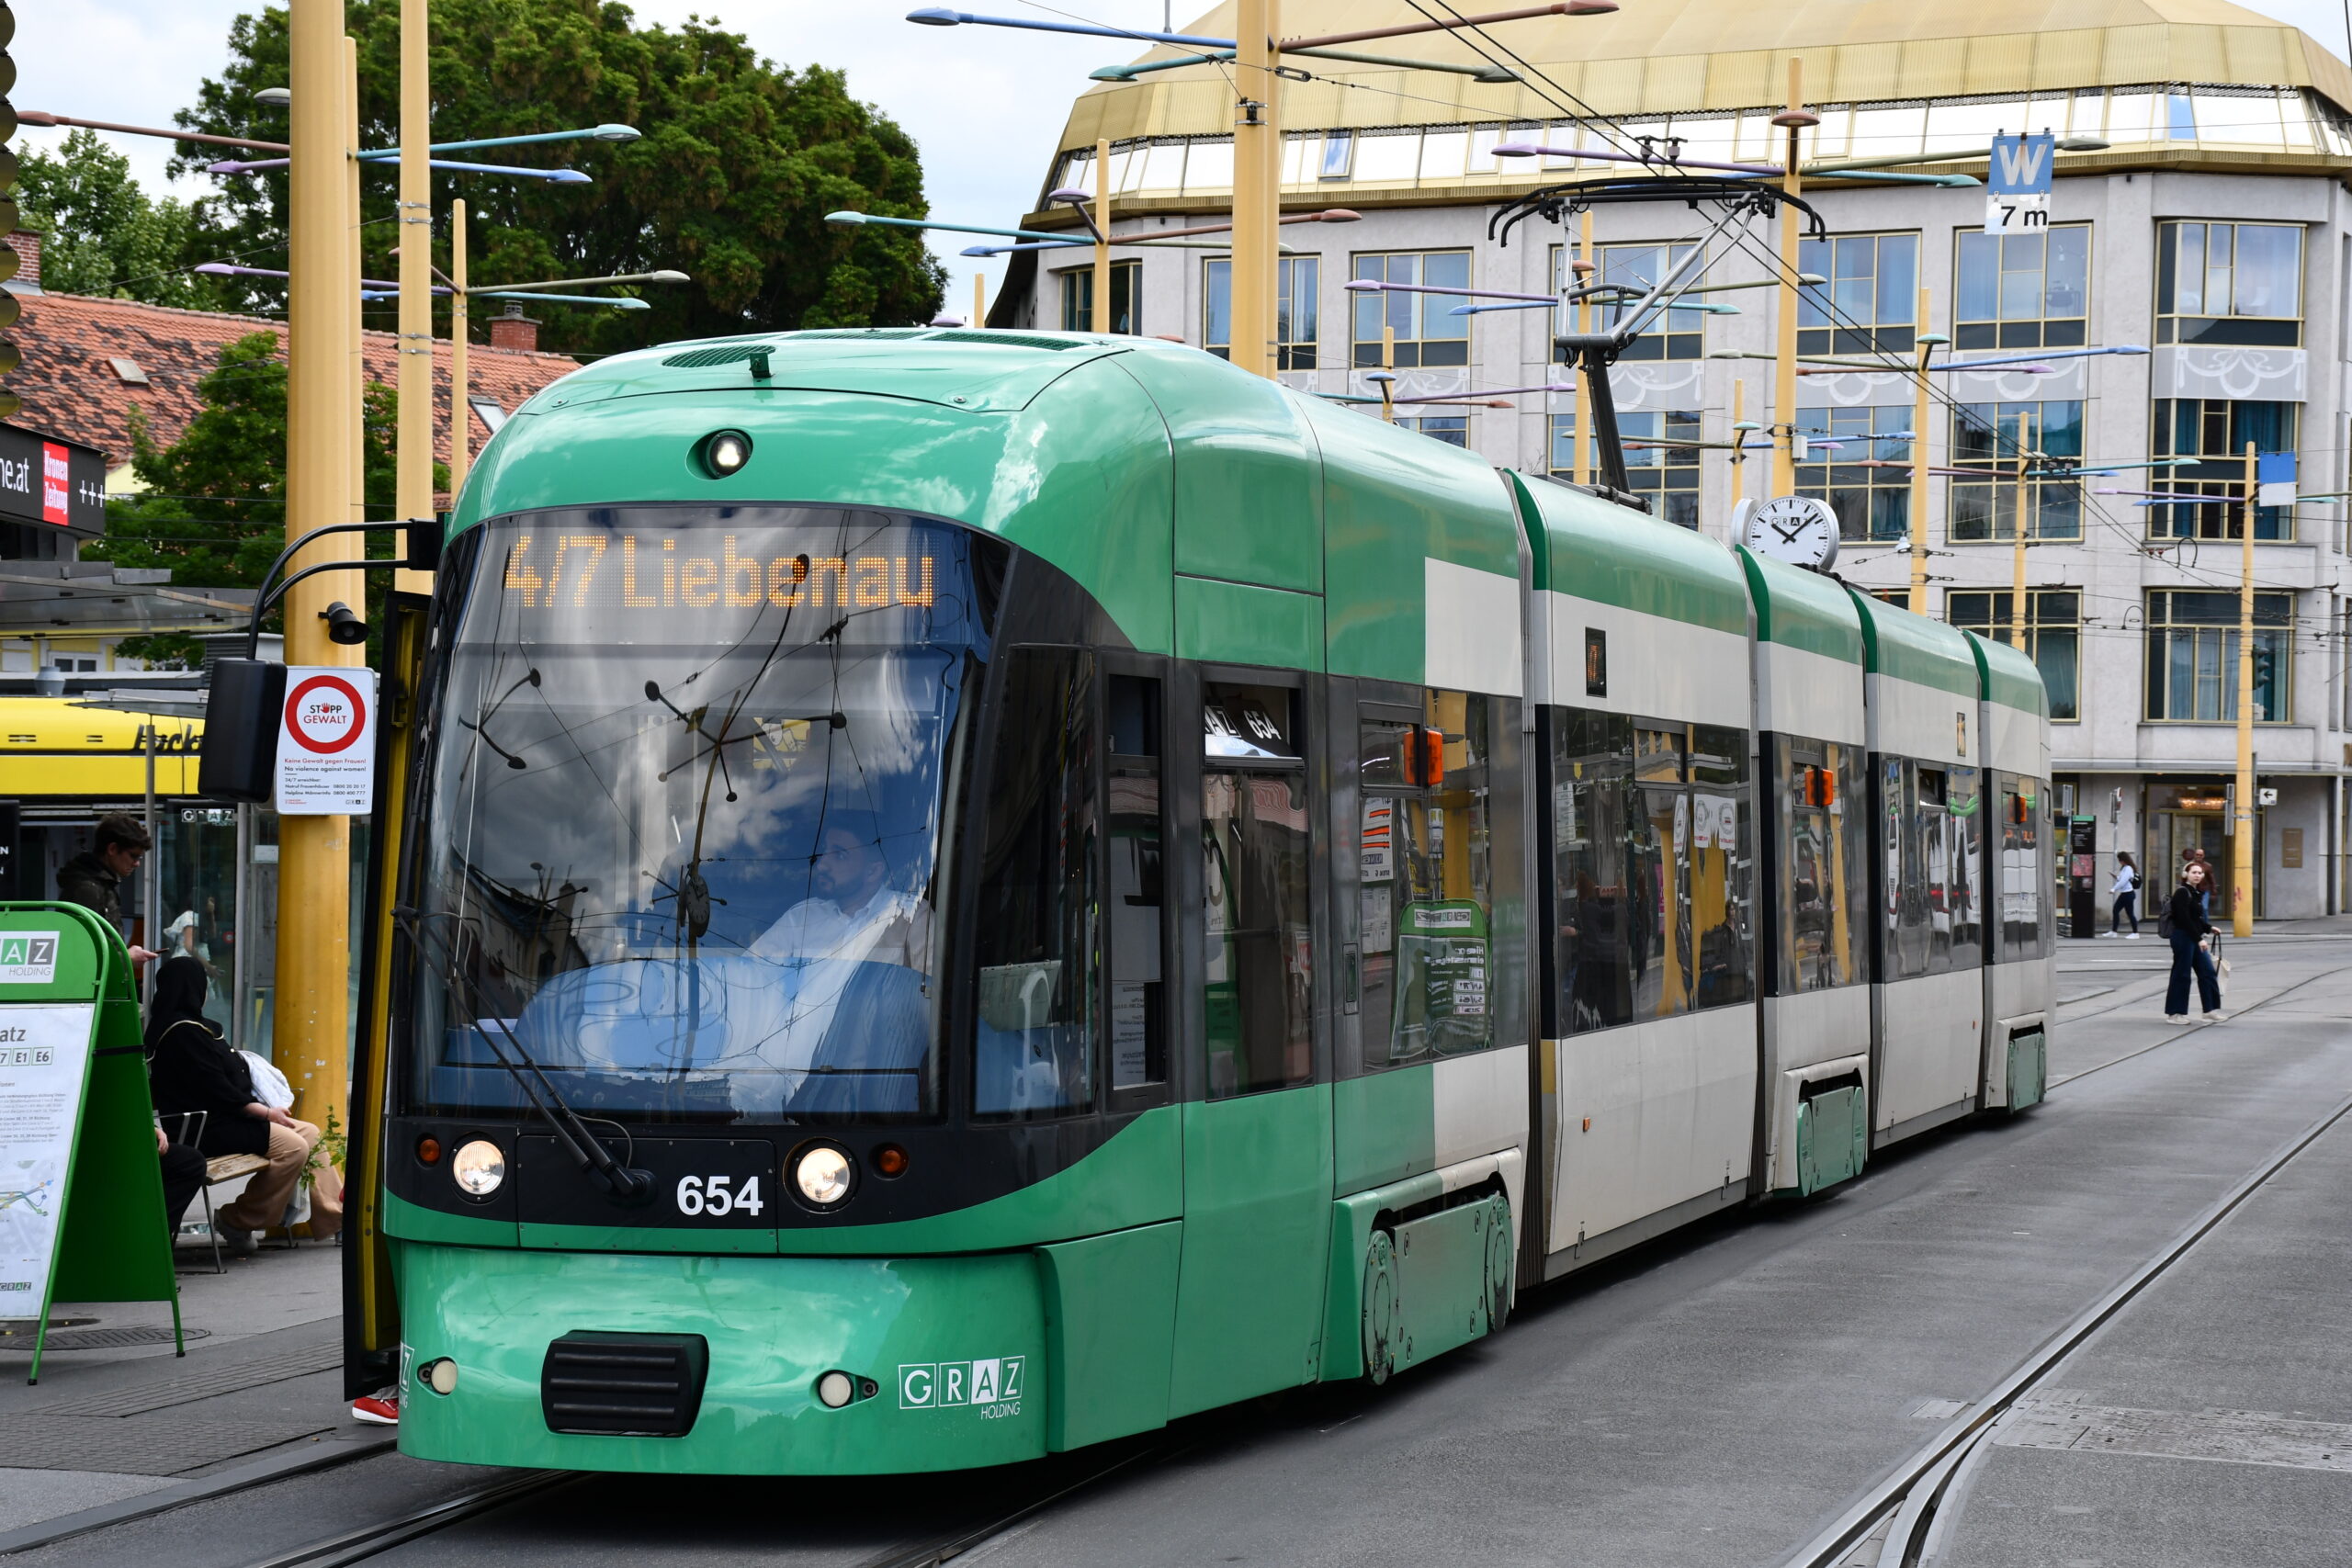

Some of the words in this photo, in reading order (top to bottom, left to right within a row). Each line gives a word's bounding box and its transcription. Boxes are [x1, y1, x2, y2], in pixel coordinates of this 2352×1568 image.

[1998, 143, 2048, 186] W
[2000, 206, 2017, 227] 7
[2023, 209, 2048, 227] m
[44, 450, 68, 481] Kronen
[44, 481, 68, 514] Zeitung
[505, 536, 607, 608] 4/7
[623, 536, 933, 608] Liebenau
[303, 716, 347, 725] GEWALT
[1243, 710, 1282, 740] 654
[9, 967, 51, 976] HOLDING
[16, 1052, 28, 1063] E1
[35, 1051, 50, 1062] E6
[677, 1175, 763, 1216] 654
[902, 1361, 1021, 1405] GRAZ
[980, 1401, 1021, 1420] HOLDING
